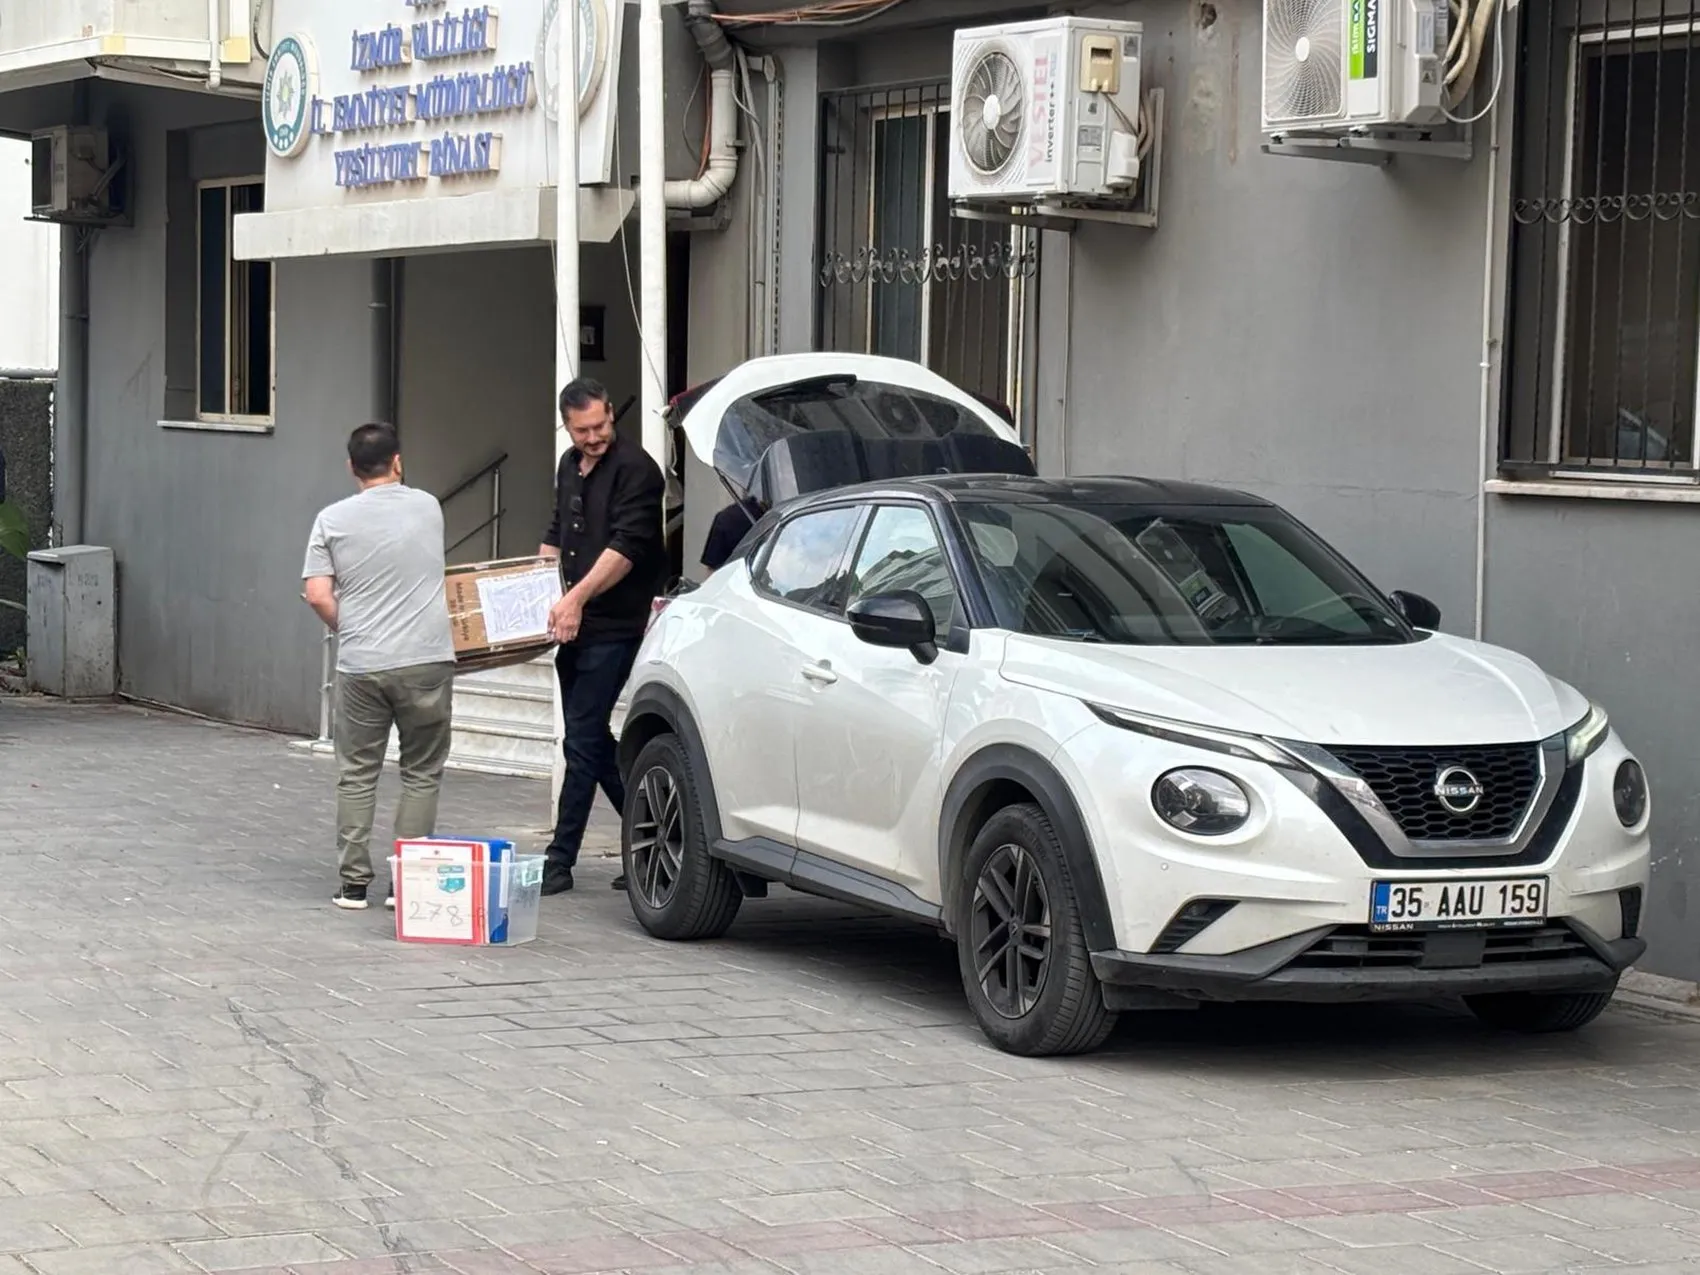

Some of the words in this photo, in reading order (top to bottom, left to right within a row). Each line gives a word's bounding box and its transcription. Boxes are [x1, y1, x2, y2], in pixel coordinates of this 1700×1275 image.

[351, 23, 404, 71] İZMİR
[332, 85, 411, 131] EMNİYET
[1028, 57, 1049, 167] VESTEL
[1045, 102, 1056, 163] inverter
[334, 142, 423, 187] YEŞİLYURT
[430, 131, 494, 176] BİNASI
[1434, 784, 1484, 796] NISSAN
[1376, 905, 1388, 914] TR
[1391, 887, 1423, 918] 35
[1437, 885, 1485, 917] AAU
[1499, 883, 1542, 915] 159
[1374, 923, 1414, 932] NISSAN
